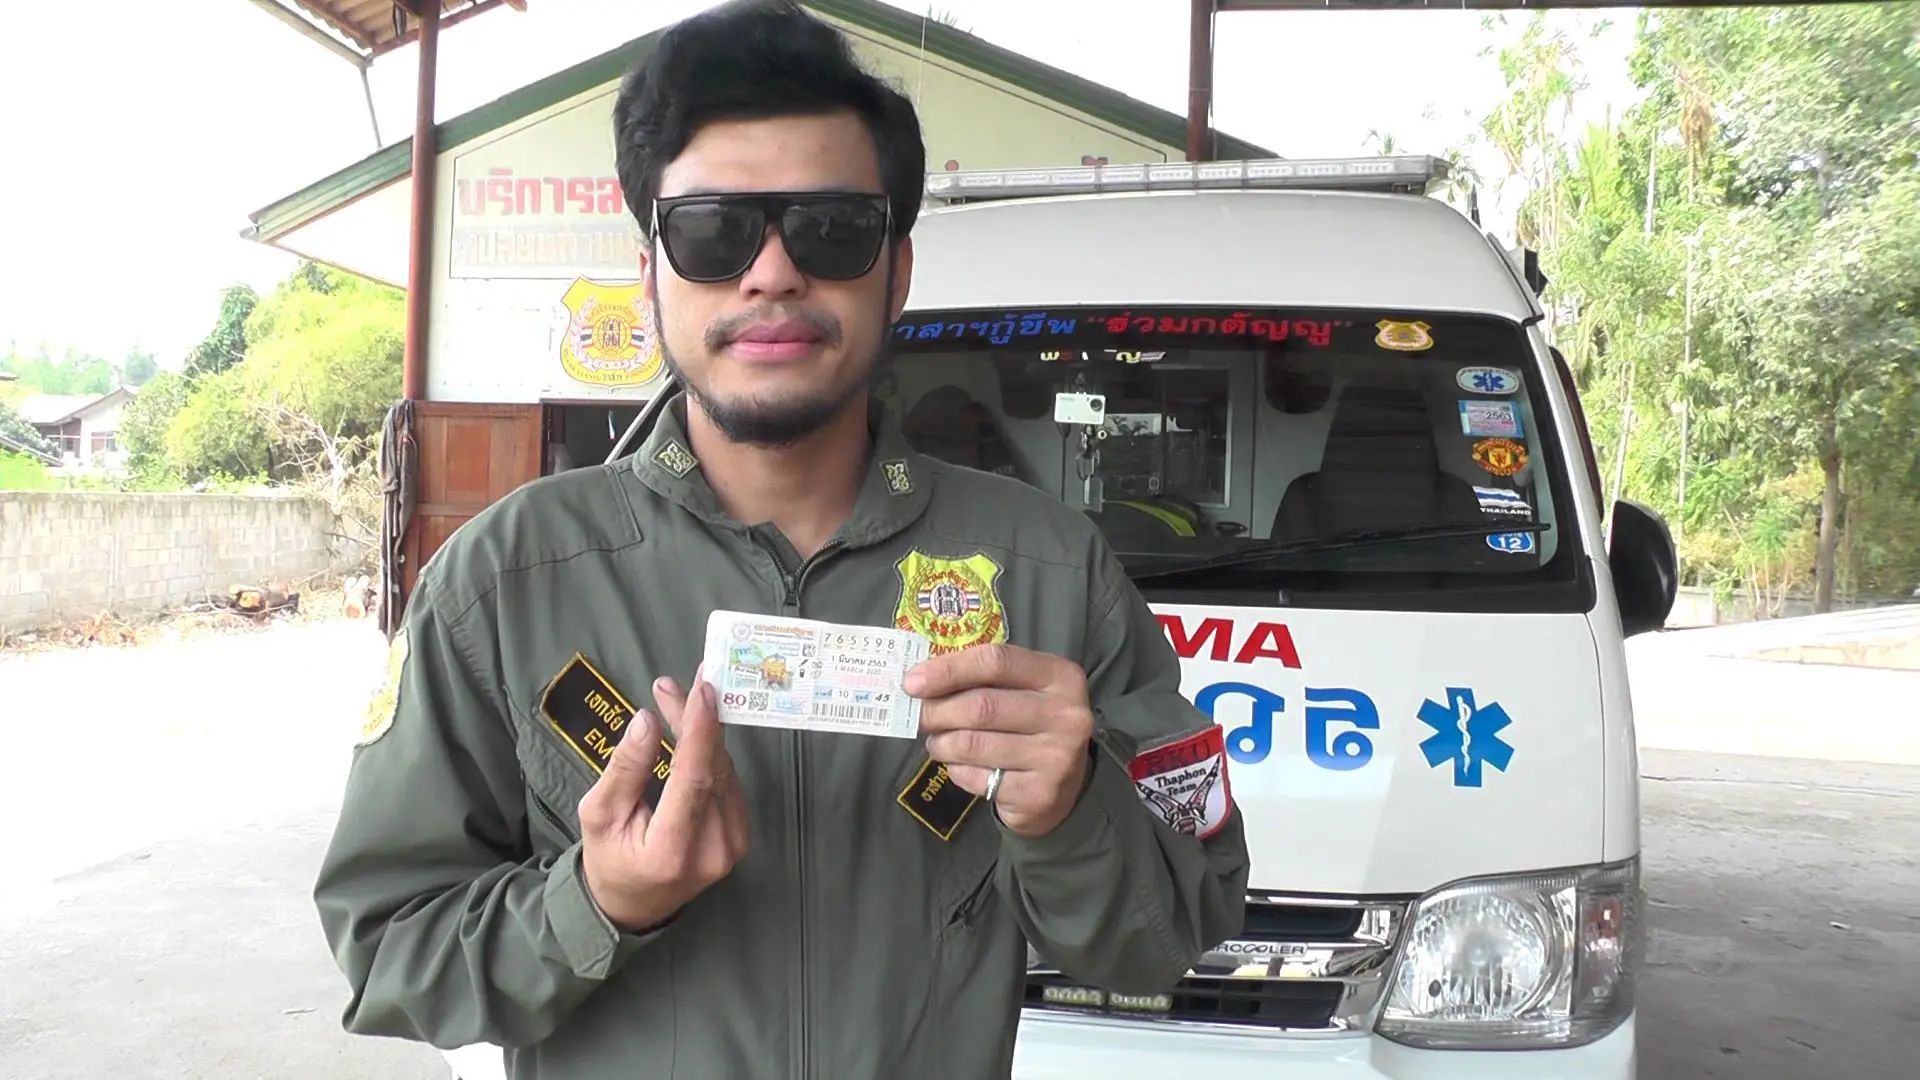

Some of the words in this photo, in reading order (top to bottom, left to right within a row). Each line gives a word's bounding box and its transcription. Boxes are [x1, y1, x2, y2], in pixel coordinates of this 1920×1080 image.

[896, 312, 1077, 345] าสาฯกู้ชีพ
[1480, 507, 1532, 516] THAILAND
[1497, 538, 1522, 549] 12
[824, 633, 895, 650] 765598
[723, 692, 747, 706] 80
[584, 689, 625, 731] เอกชัย
[583, 728, 616, 760] EM
[1154, 768, 1207, 788] Thaphon
[1165, 782, 1197, 797] Team
